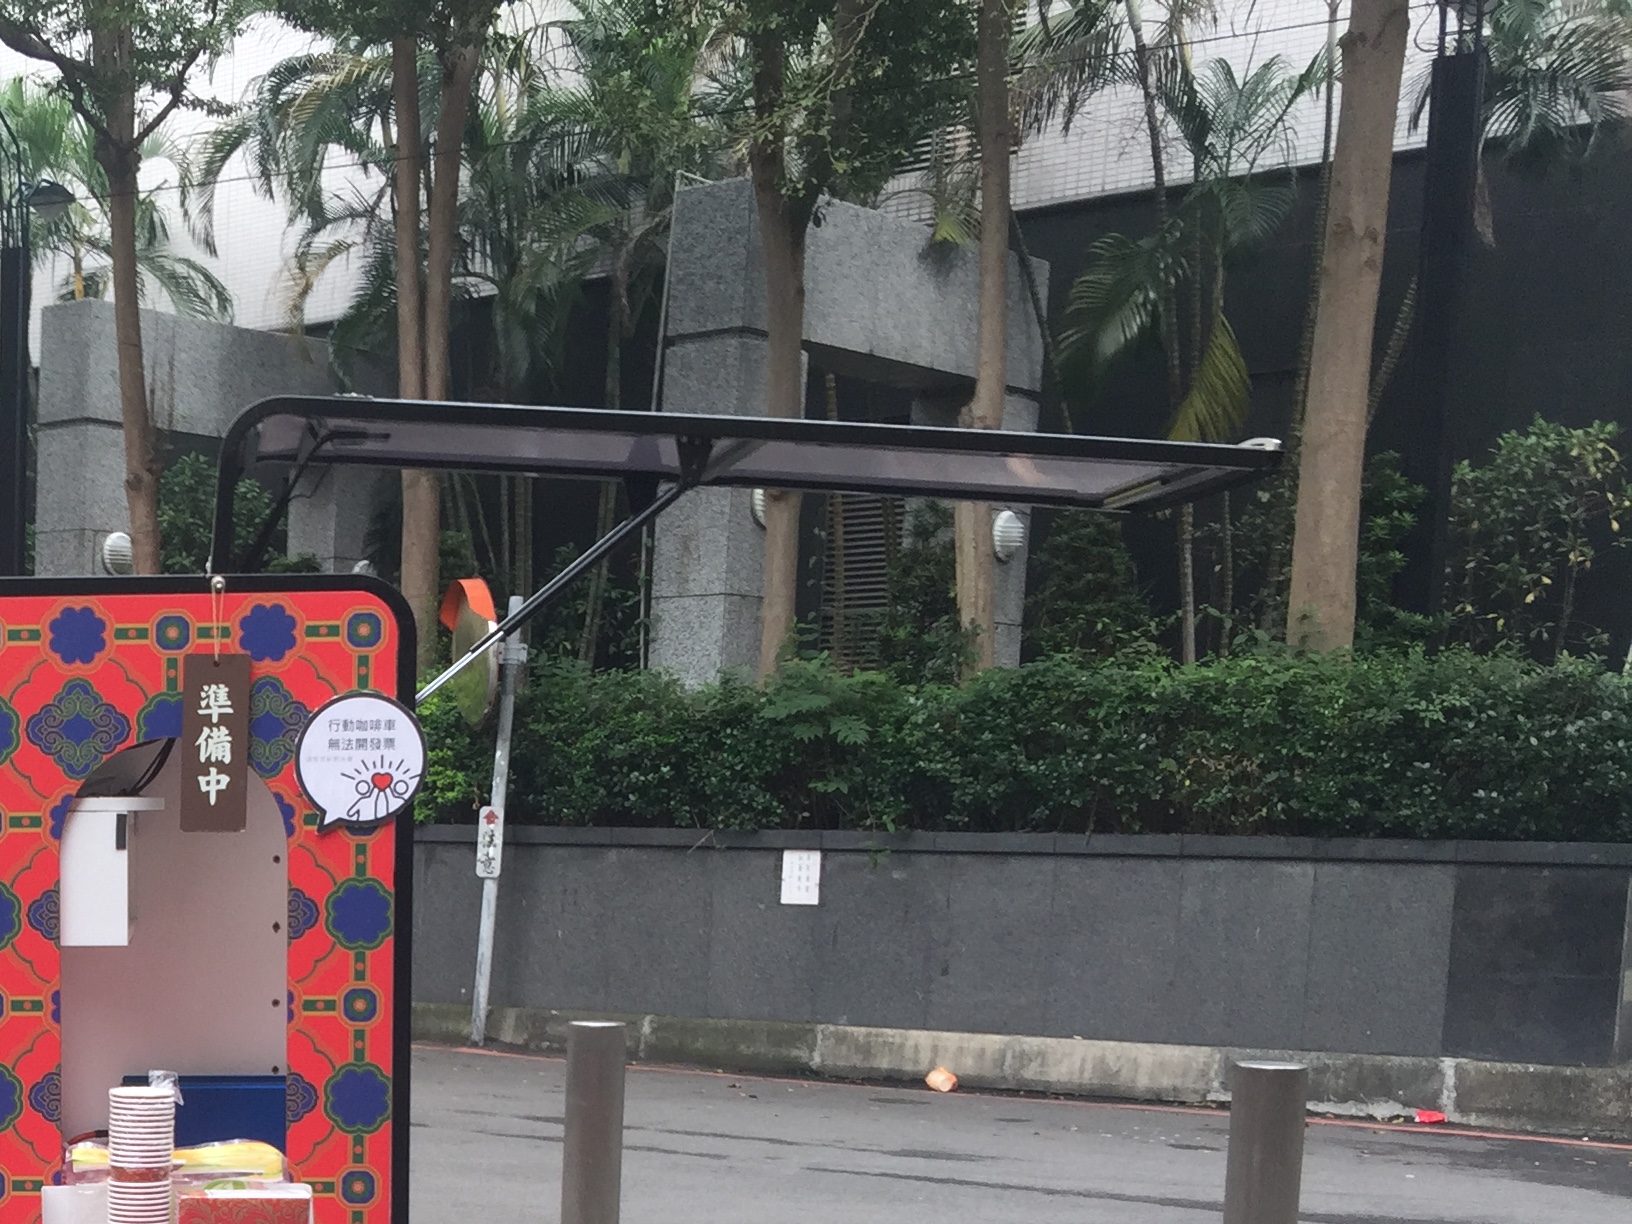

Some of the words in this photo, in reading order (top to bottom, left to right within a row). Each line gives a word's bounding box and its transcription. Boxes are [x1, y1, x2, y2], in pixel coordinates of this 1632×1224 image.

[328, 719, 396, 733] 行動咖啡車
[195, 684, 234, 806] 準備中
[328, 738, 396, 751] 無法開發票
